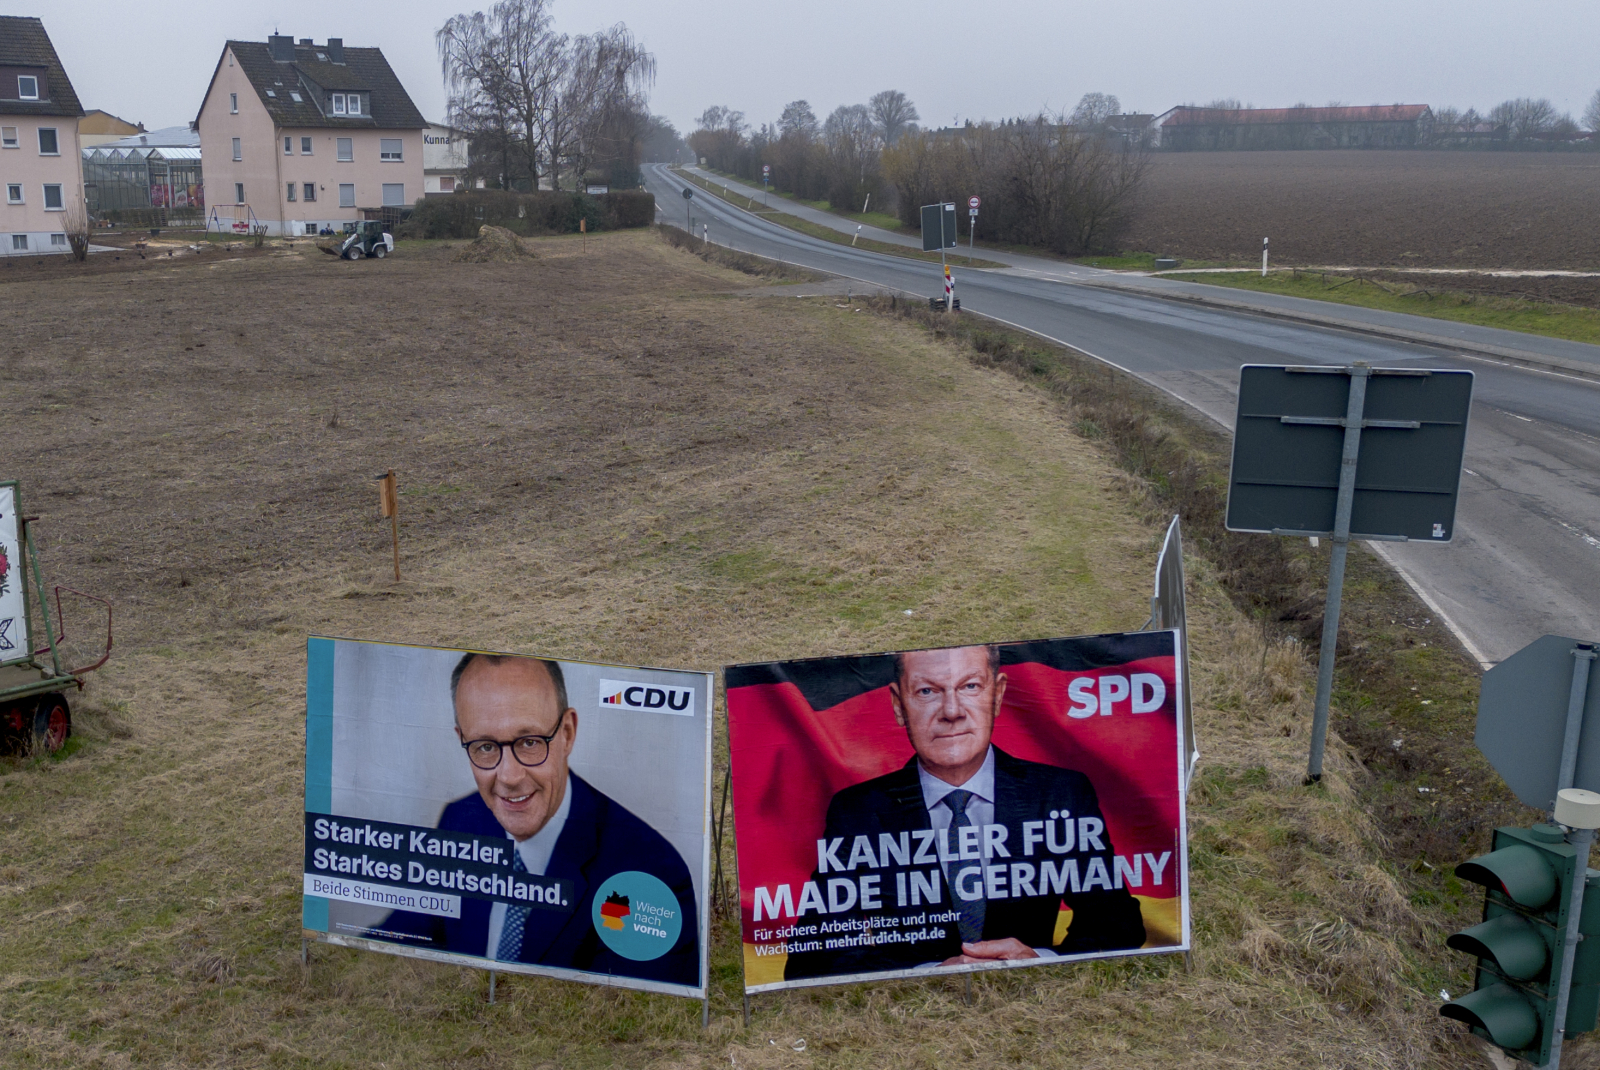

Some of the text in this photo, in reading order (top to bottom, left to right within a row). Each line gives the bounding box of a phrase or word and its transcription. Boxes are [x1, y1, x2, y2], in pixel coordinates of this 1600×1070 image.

[624, 686, 690, 711] CDU
[1067, 673, 1166, 719] SPD
[314, 818, 508, 866] Starker Kanzler.
[817, 809, 1106, 873] KANZLER FÜR
[313, 848, 568, 906] Starkes Deutschland.
[753, 875, 882, 922] MADE
[896, 869, 942, 907] IN
[955, 851, 1172, 901] GERMANY
[313, 879, 453, 913] Beide Stimmen CDU.
[636, 900, 675, 919] Wieder
[633, 923, 667, 938] vorne
[634, 912, 662, 926] nach
[754, 909, 961, 942] Für sichere Arbeitsplätze und mehr
[754, 927, 946, 957] Wachstum: mehrfürdich.spd.de
